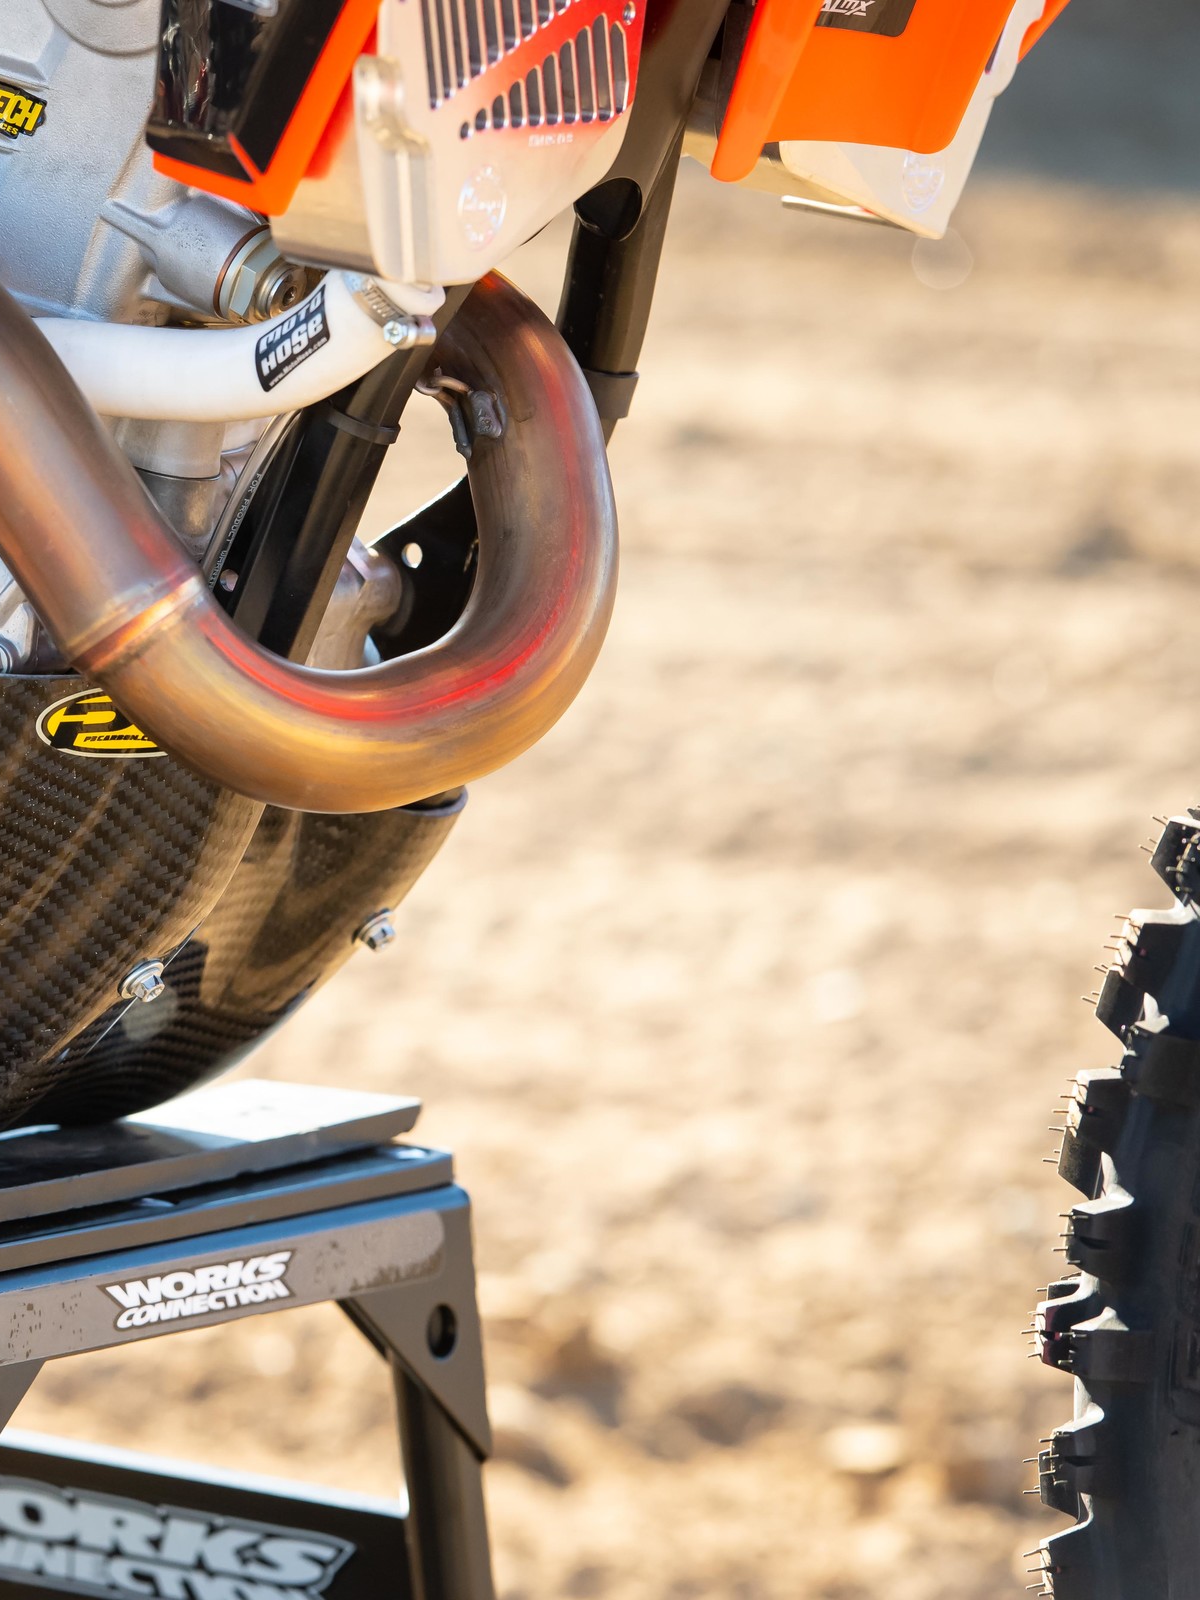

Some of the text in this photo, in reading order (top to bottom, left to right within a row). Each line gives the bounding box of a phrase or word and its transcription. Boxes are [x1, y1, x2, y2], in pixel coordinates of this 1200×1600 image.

[247, 473, 262, 493] FOR
[226, 498, 250, 544] PRODUCT
[105, 1251, 292, 1308] WORKS
[116, 1279, 291, 1329] CONNECTION
